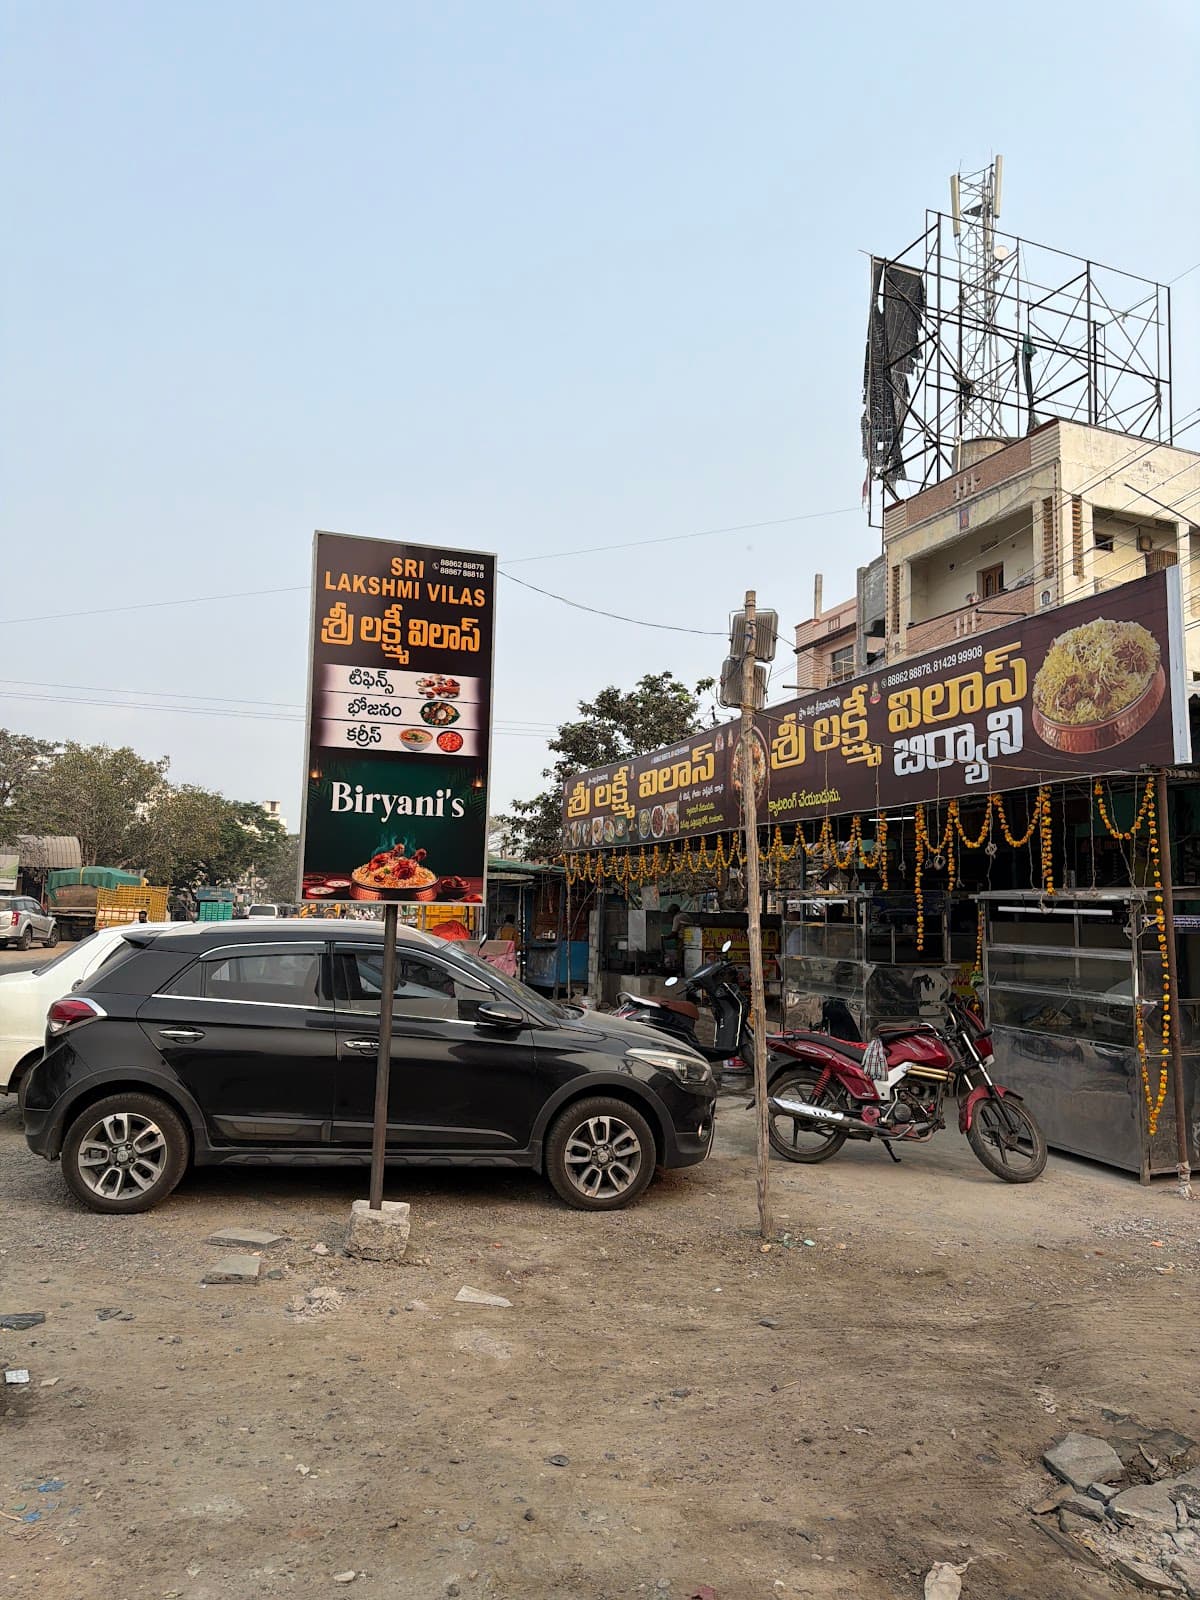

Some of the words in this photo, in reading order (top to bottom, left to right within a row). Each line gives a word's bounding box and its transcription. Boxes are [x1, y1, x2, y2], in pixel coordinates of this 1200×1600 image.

[391, 557, 424, 579] SRI
[440, 559, 462, 568] 88862
[463, 562, 485, 570] 88878
[325, 571, 420, 600] LAKSHMI
[427, 583, 486, 607] VILAS
[321, 602, 354, 645] శ్రీ
[360, 603, 409, 665] లక్ష్మీ
[408, 617, 481, 652] విలాస్
[887, 670, 908, 687] 88862
[933, 654, 956, 672] 81429
[957, 645, 982, 664] 99908
[348, 697, 402, 717] భోజనం
[771, 713, 806, 771] శ్రీ
[813, 683, 882, 768] లక్ష్మీ
[888, 641, 1027, 734] విలాస్
[893, 706, 1024, 785] బిర్యాని
[330, 781, 465, 823] Biryani's
[568, 781, 591, 818] శ్రీ
[594, 765, 636, 819] లక్ష్మీ
[638, 743, 715, 799] విలాస్
